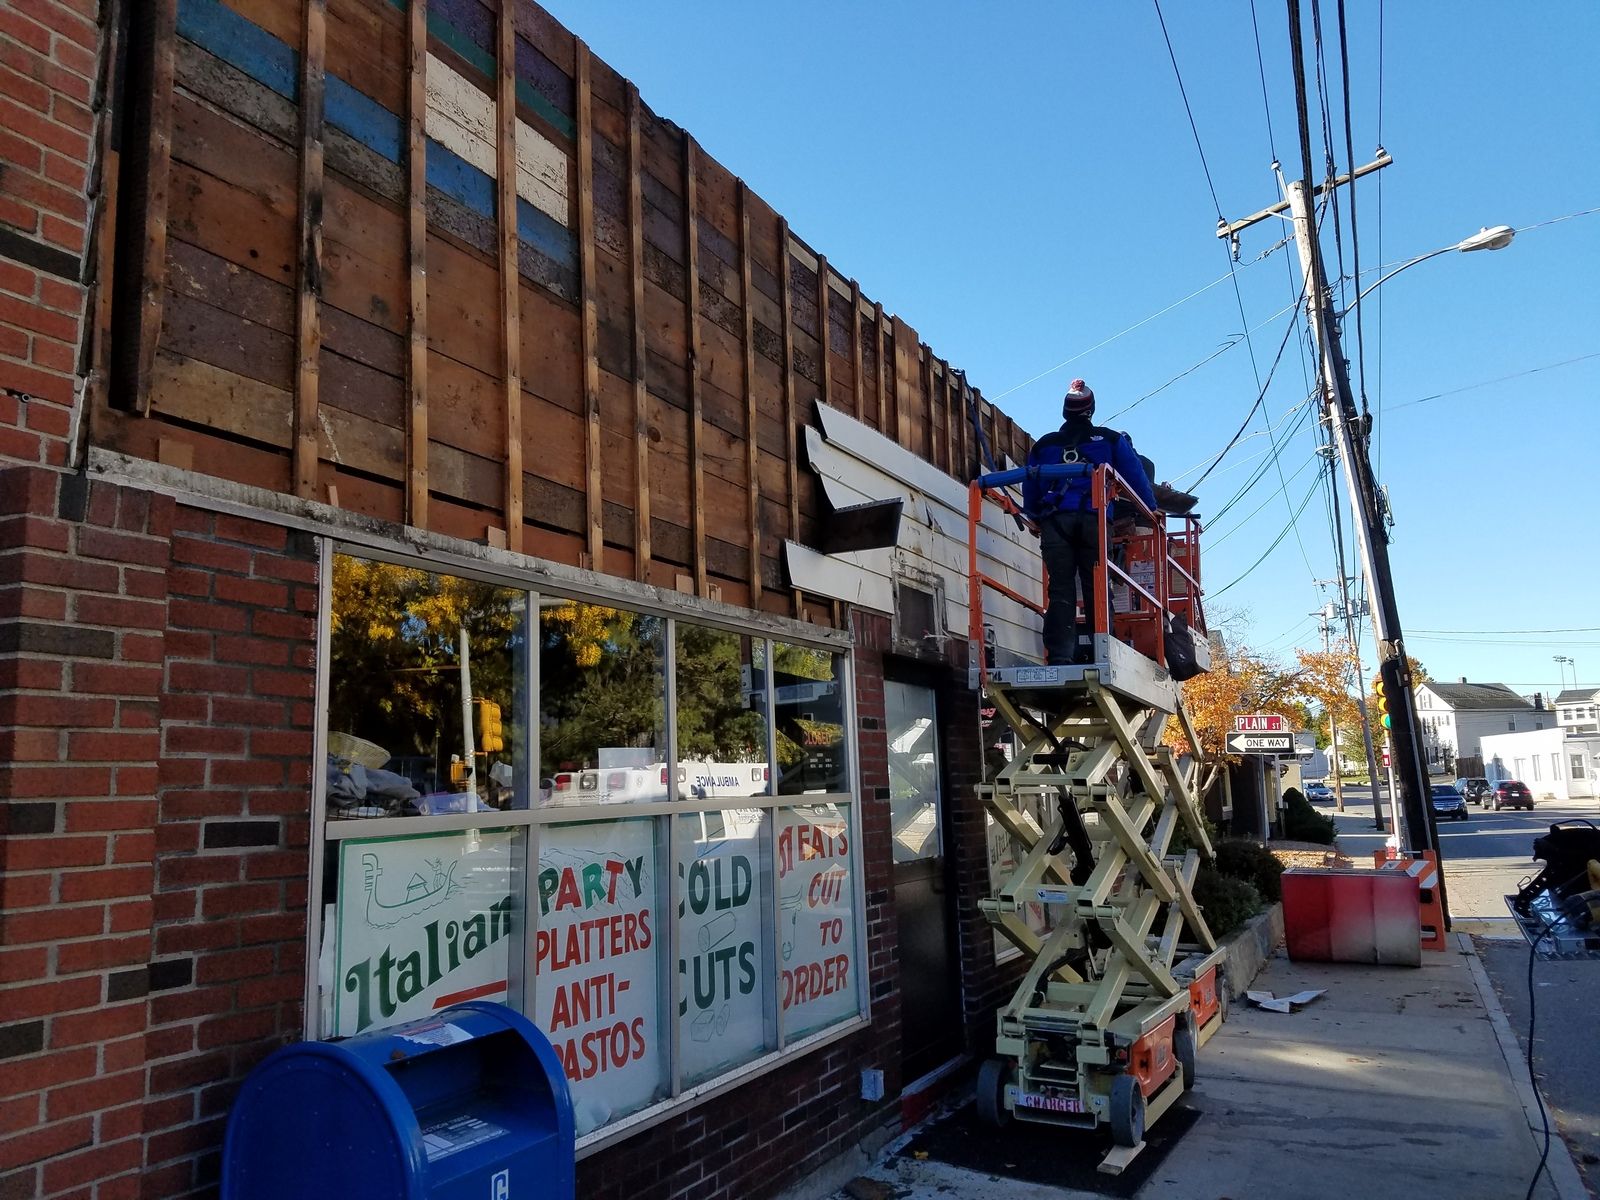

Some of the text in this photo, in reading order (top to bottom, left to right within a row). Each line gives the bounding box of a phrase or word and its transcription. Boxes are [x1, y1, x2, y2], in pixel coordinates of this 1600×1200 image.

[1238, 717, 1268, 730] PLAIN
[1246, 739, 1286, 747] ONE WAY
[538, 856, 643, 917] PARTY
[808, 870, 847, 908] CUT
[536, 909, 651, 975] PLATTERS
[820, 918, 842, 946] TO
[345, 896, 511, 1034] Italian
[550, 973, 630, 1033] ANTI-
